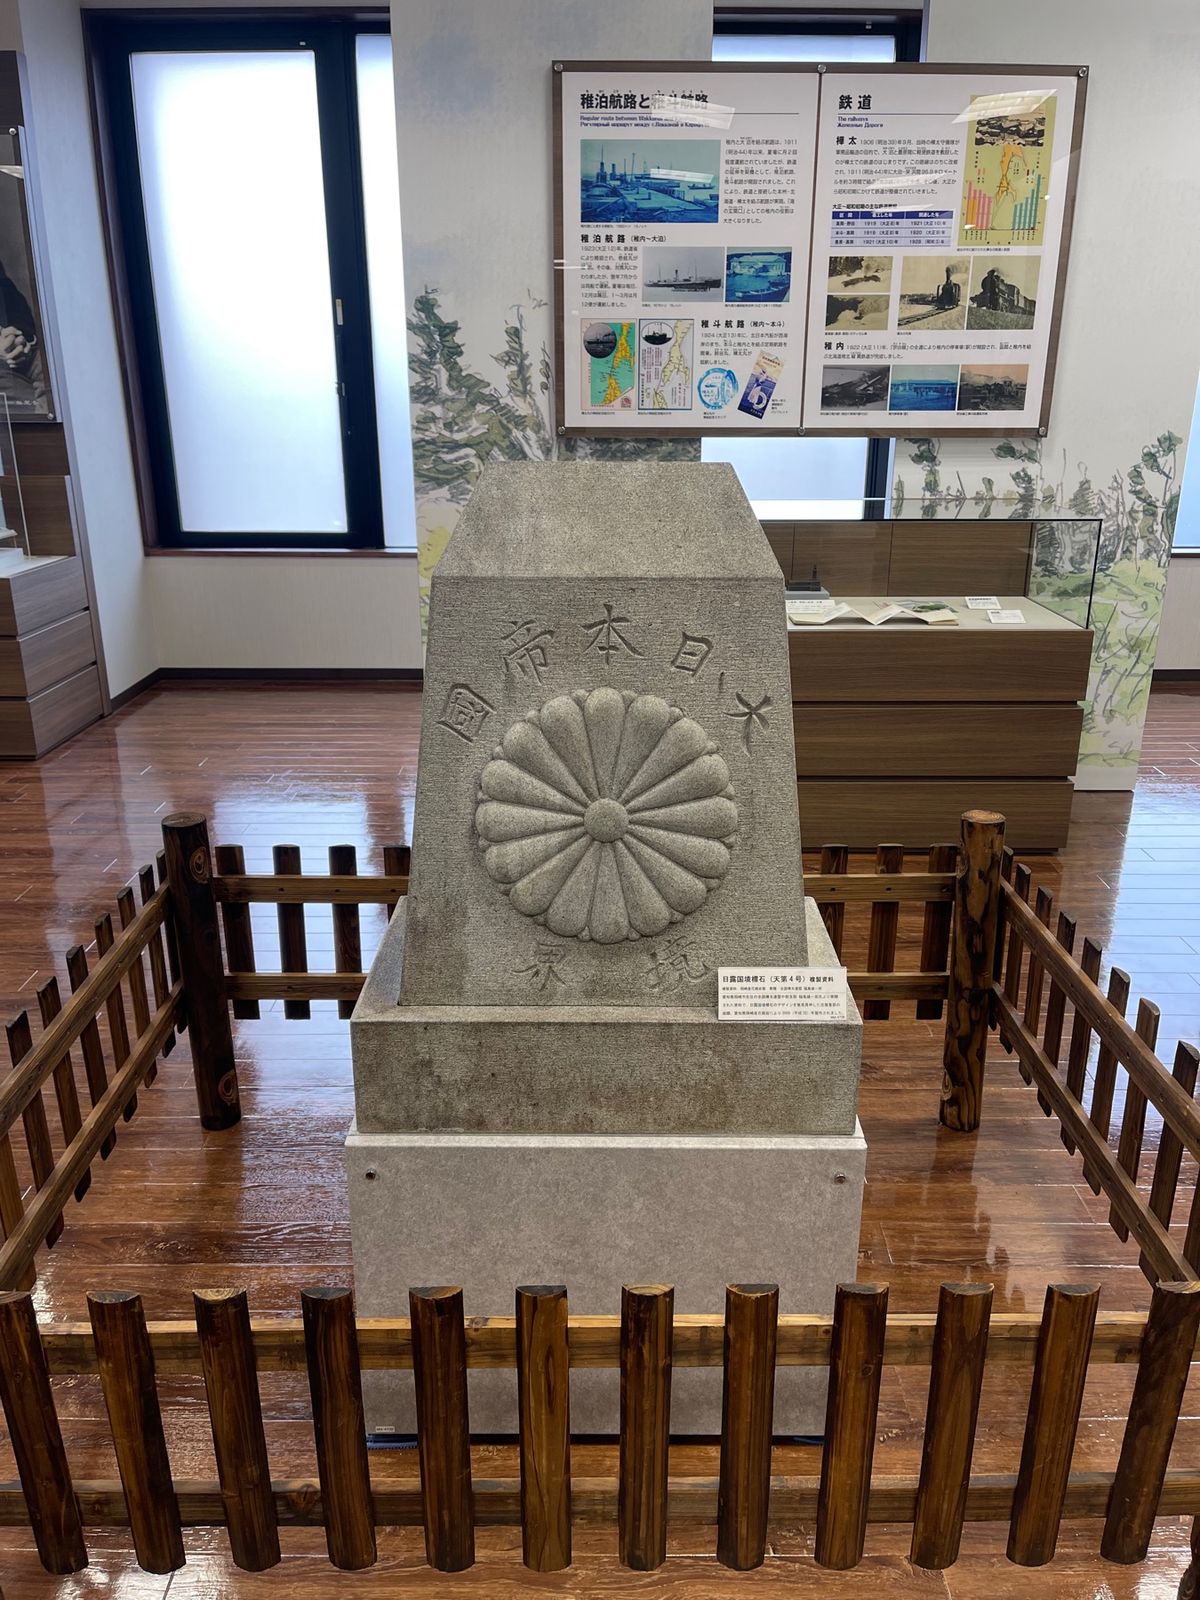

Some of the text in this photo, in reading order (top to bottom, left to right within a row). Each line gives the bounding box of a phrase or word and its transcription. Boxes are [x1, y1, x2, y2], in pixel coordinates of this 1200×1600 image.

[838, 94, 872, 110] 鉄道
[581, 234, 625, 243] 稚泊航路
[701, 320, 745, 328] 稚斗航路
[824, 342, 845, 351] 稚内
